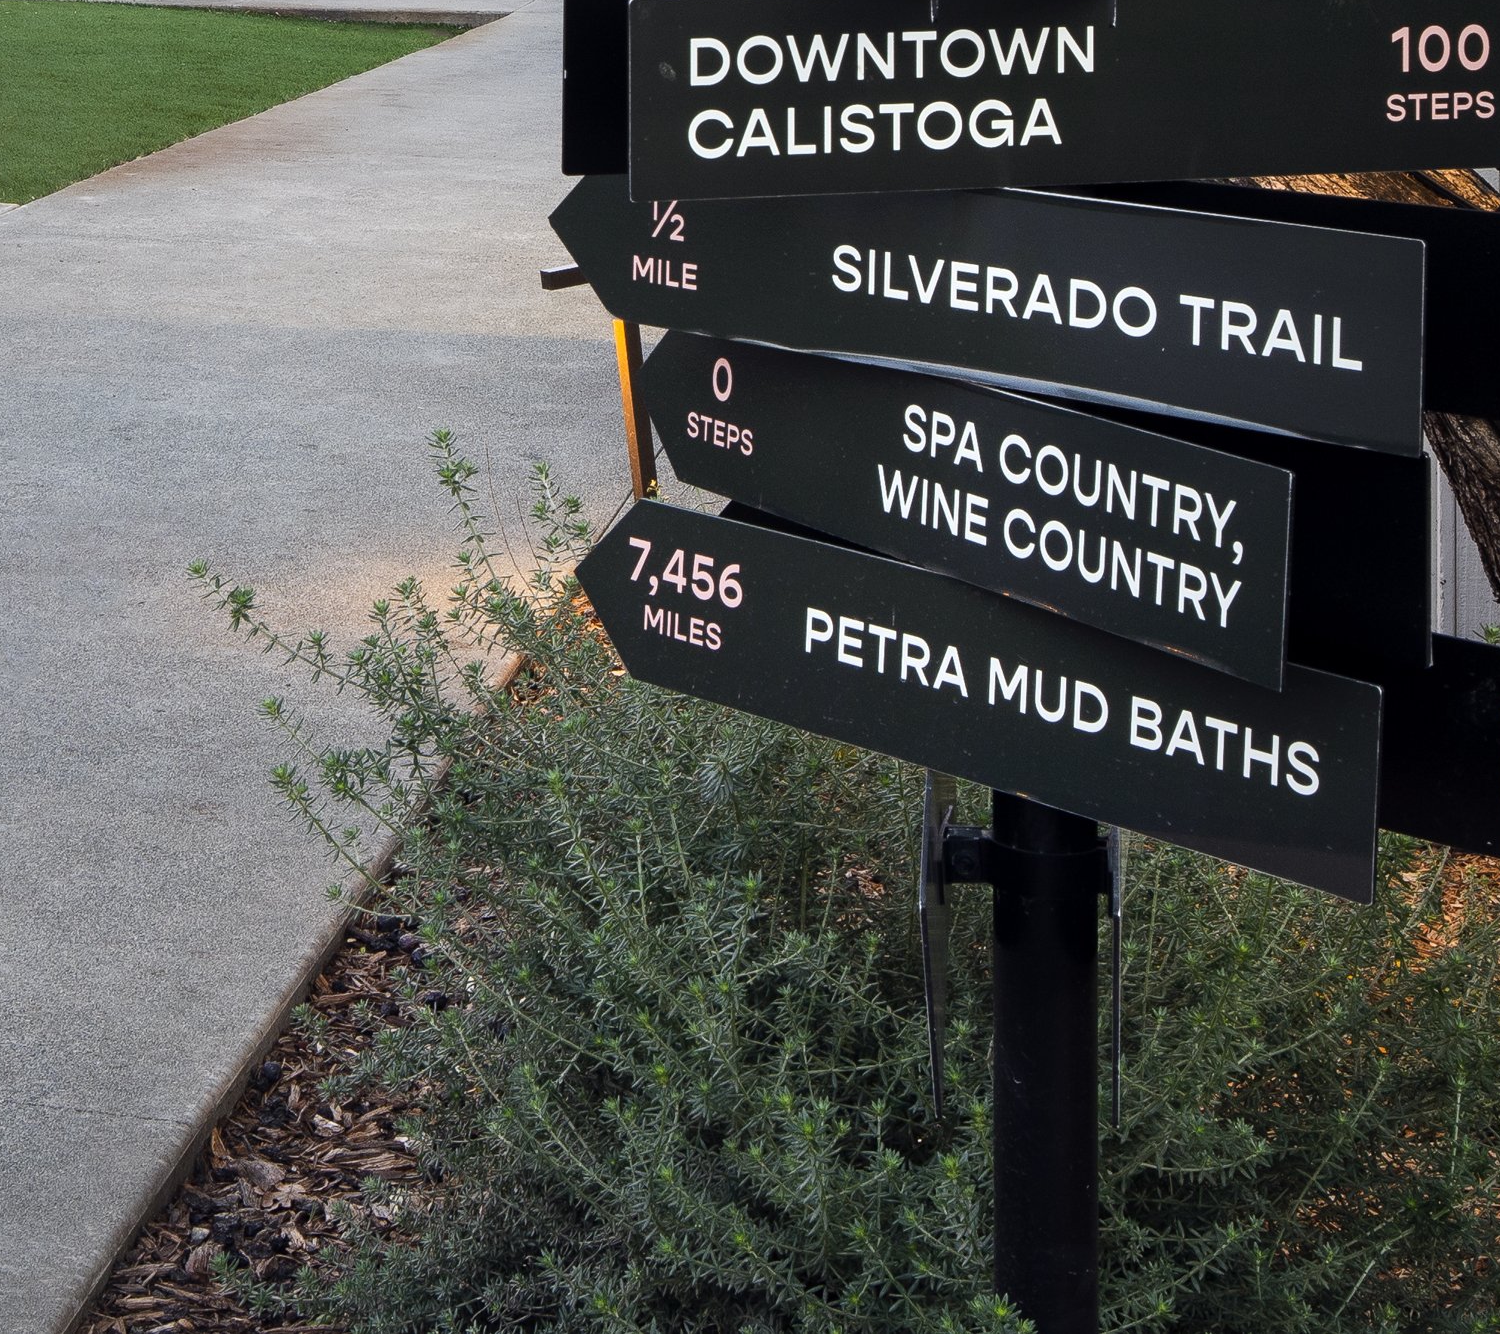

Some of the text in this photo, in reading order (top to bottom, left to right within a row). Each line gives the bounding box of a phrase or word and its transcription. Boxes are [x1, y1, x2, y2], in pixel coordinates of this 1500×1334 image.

[690, 25, 1094, 87] DOWNTOWN
[1391, 23, 1490, 73] 100
[687, 98, 1063, 160] CALISTOGA
[1386, 90, 1495, 122] STEPS
[632, 254, 698, 291] MILE
[831, 244, 1363, 372] SILVERADO TRAIL
[712, 357, 733, 402] 0
[686, 411, 753, 456] STEPS
[902, 404, 1244, 572] SPA COUNTRY,
[629, 536, 743, 608] 7,456
[877, 464, 1244, 628] WINE COUNTRY
[643, 604, 722, 651] MILES
[805, 606, 1320, 796] PETRA MUD BATHS
